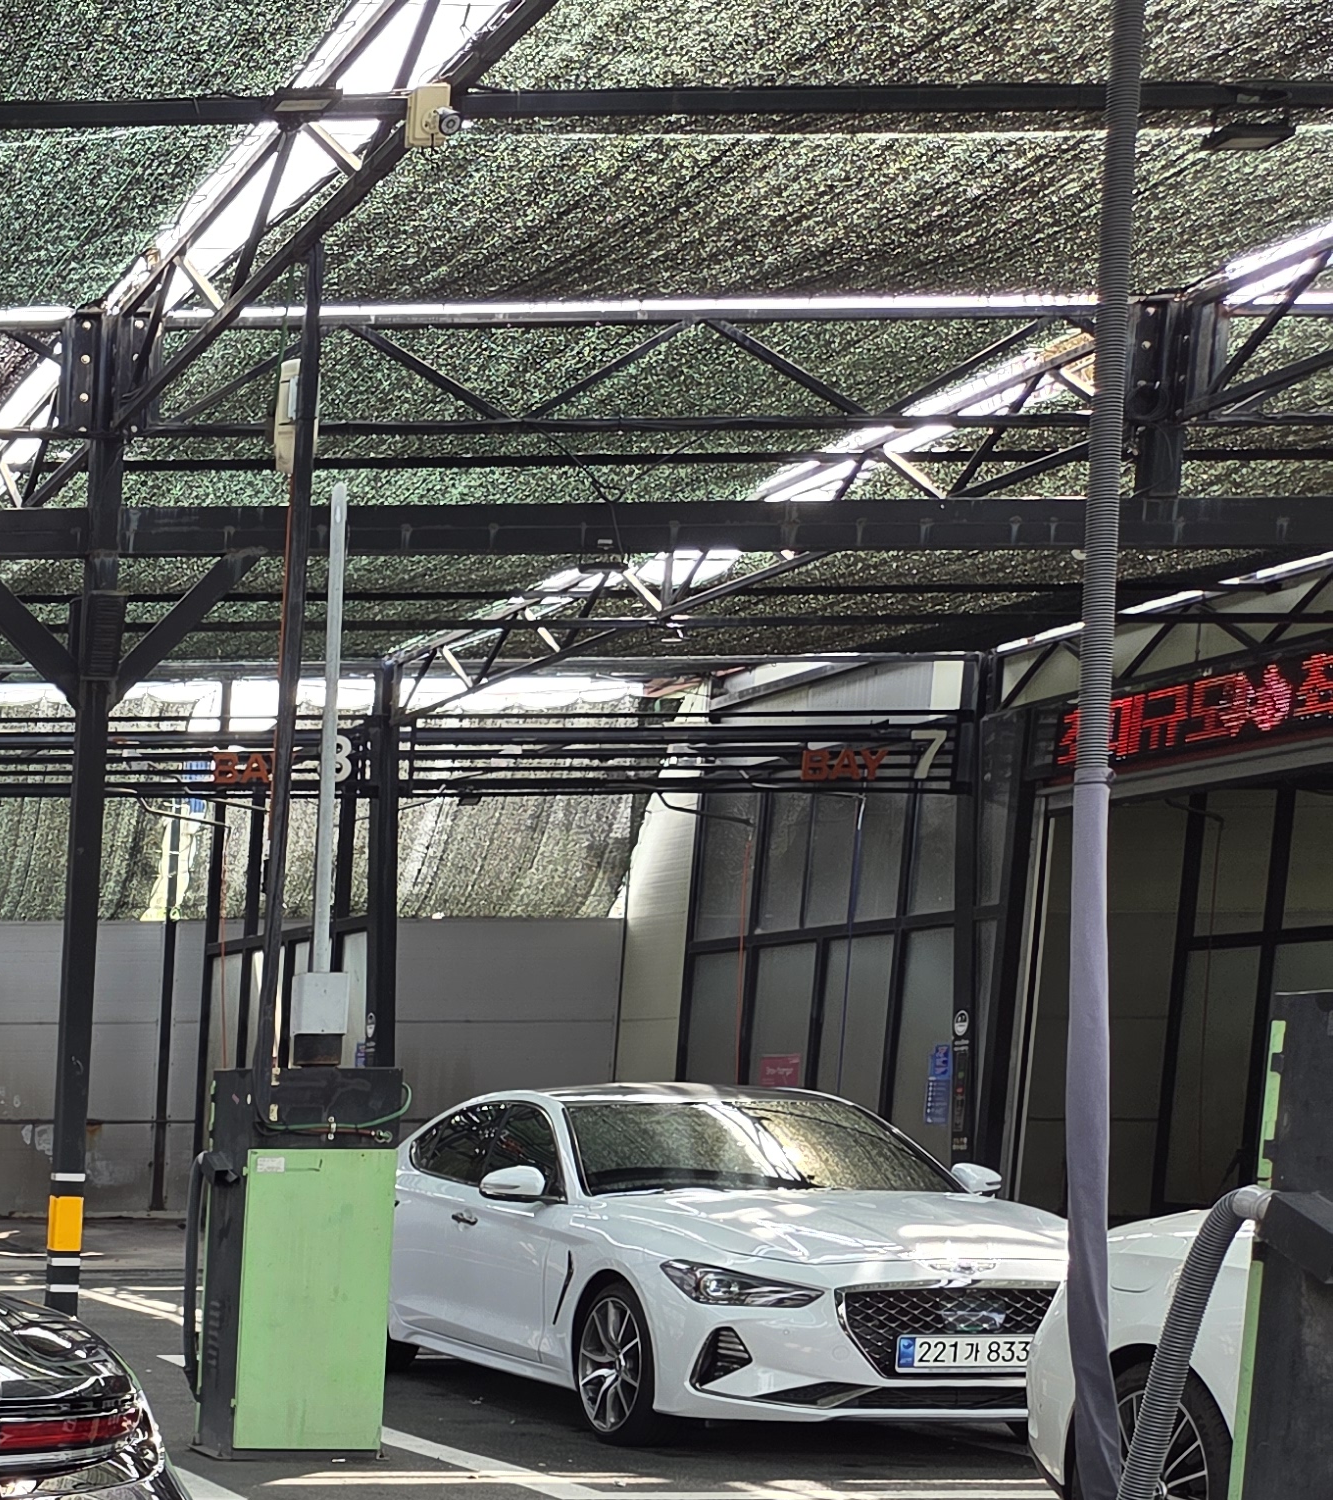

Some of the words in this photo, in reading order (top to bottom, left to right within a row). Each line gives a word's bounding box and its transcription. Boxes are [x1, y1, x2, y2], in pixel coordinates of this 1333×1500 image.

[800, 748, 889, 780] BAY
[911, 729, 947, 779] 7
[917, 1341, 981, 1363] 221가
